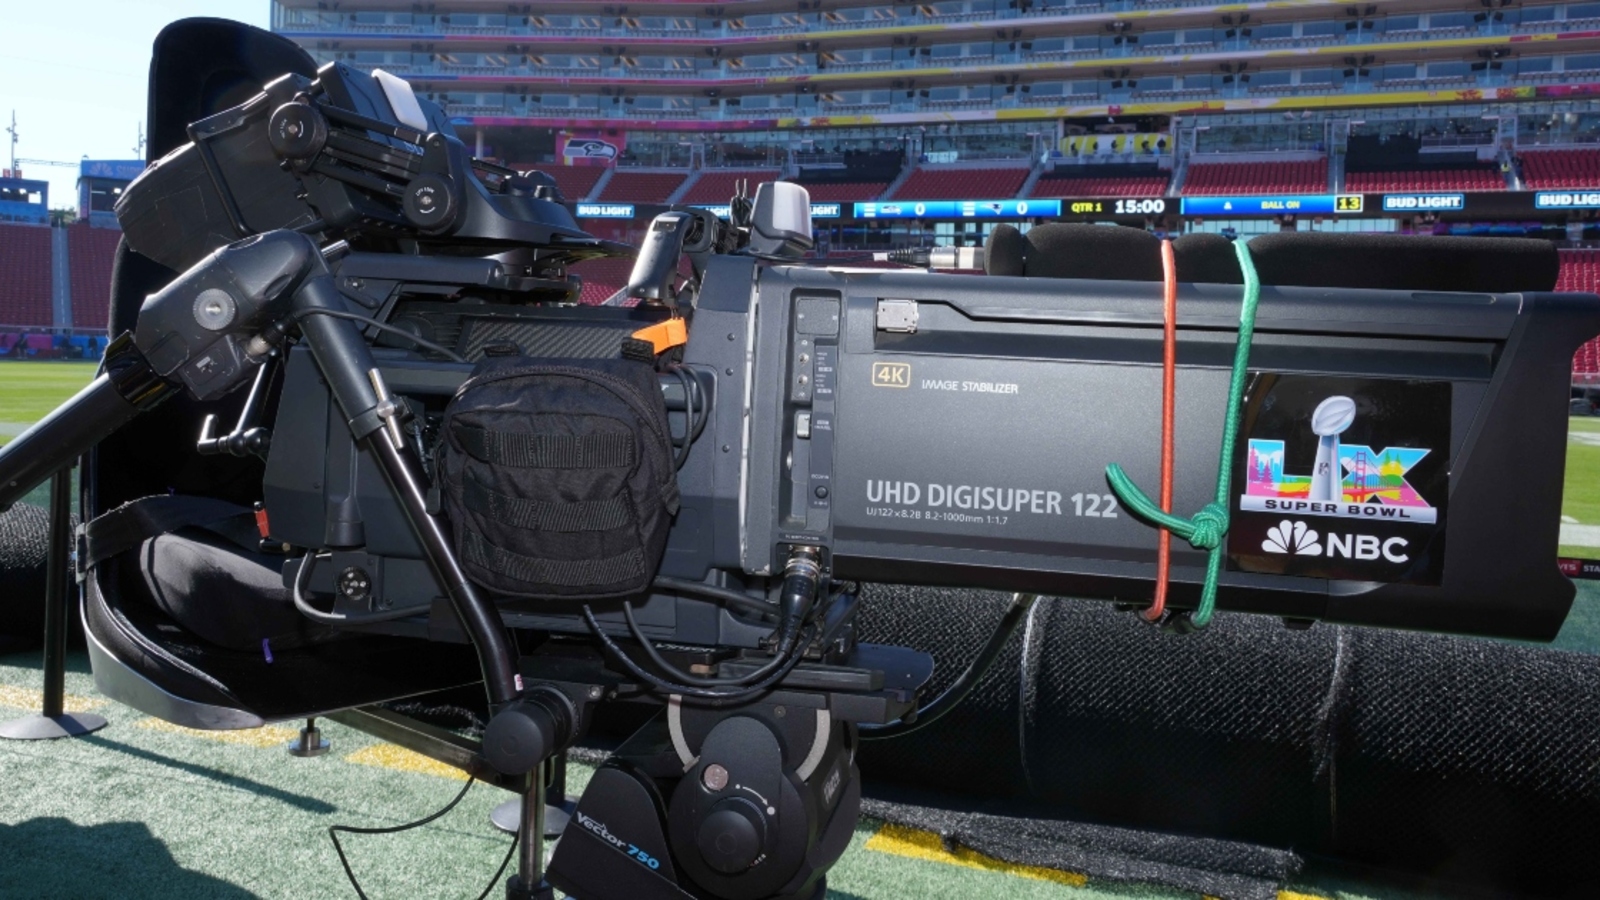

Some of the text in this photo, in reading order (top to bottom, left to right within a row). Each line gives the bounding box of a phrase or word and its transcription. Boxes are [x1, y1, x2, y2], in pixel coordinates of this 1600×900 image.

[1115, 200, 1164, 213] 15:00
[1261, 198, 1359, 210] BALL ON 13
[1386, 196, 1460, 208] BUD LIGHT
[1539, 194, 1600, 205] BUD LIG
[579, 206, 631, 215] BUD LIGHT
[915, 203, 925, 216] 0
[1016, 201, 1028, 215] 0
[1071, 203, 1102, 213] QTR 1
[878, 366, 905, 384] 4K
[922, 379, 1019, 394] IMAGE STABILIZER
[866, 479, 1118, 518] UHD DIGISUPER 122
[1265, 499, 1411, 518] SUPER BOWL
[925, 510, 984, 524] 8.2-1000mm
[986, 514, 1008, 525] 1:1.7
[1326, 532, 1409, 563] NBC
[577, 811, 659, 870] Vector 750
